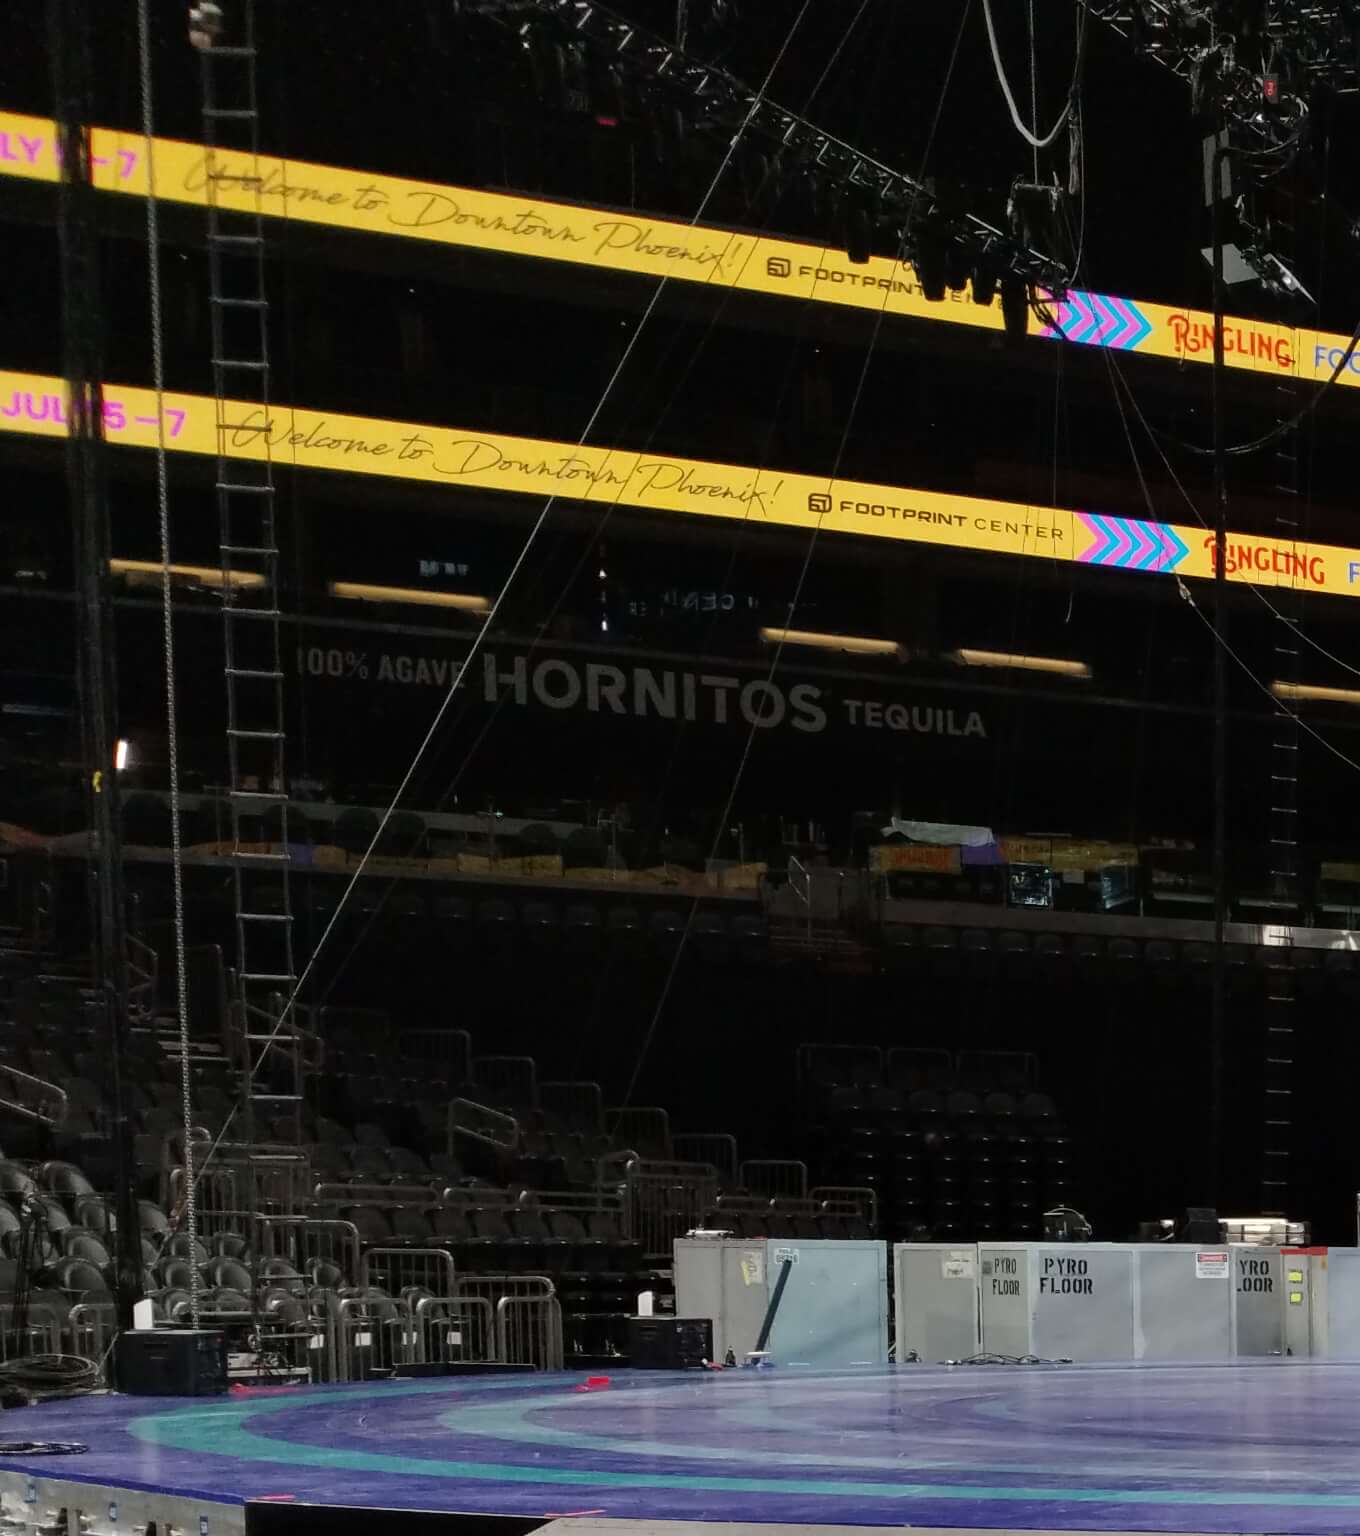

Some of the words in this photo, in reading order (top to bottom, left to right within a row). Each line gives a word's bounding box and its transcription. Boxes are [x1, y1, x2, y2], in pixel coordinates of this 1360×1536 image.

[352, 184, 389, 211] to
[388, 192, 585, 242] Downtown
[594, 222, 743, 279] Phoenix!
[231, 410, 394, 457] Welcome
[395, 432, 433, 462] to
[433, 440, 629, 486] Downtown
[636, 462, 782, 515] Phoenix!
[839, 499, 969, 527] FOOTPRINT
[973, 516, 1064, 541] CENTER
[296, 648, 369, 681] 100%
[377, 654, 465, 689] AGAVE
[482, 653, 829, 733] HORNITOS
[841, 699, 988, 737] TEQUILA
[994, 1258, 1017, 1275] PYRO
[1044, 1258, 1088, 1276] PYRO
[1239, 1260, 1269, 1276] YRO
[992, 1278, 1020, 1296] FLOOR
[1040, 1277, 1093, 1295] FLOOR
